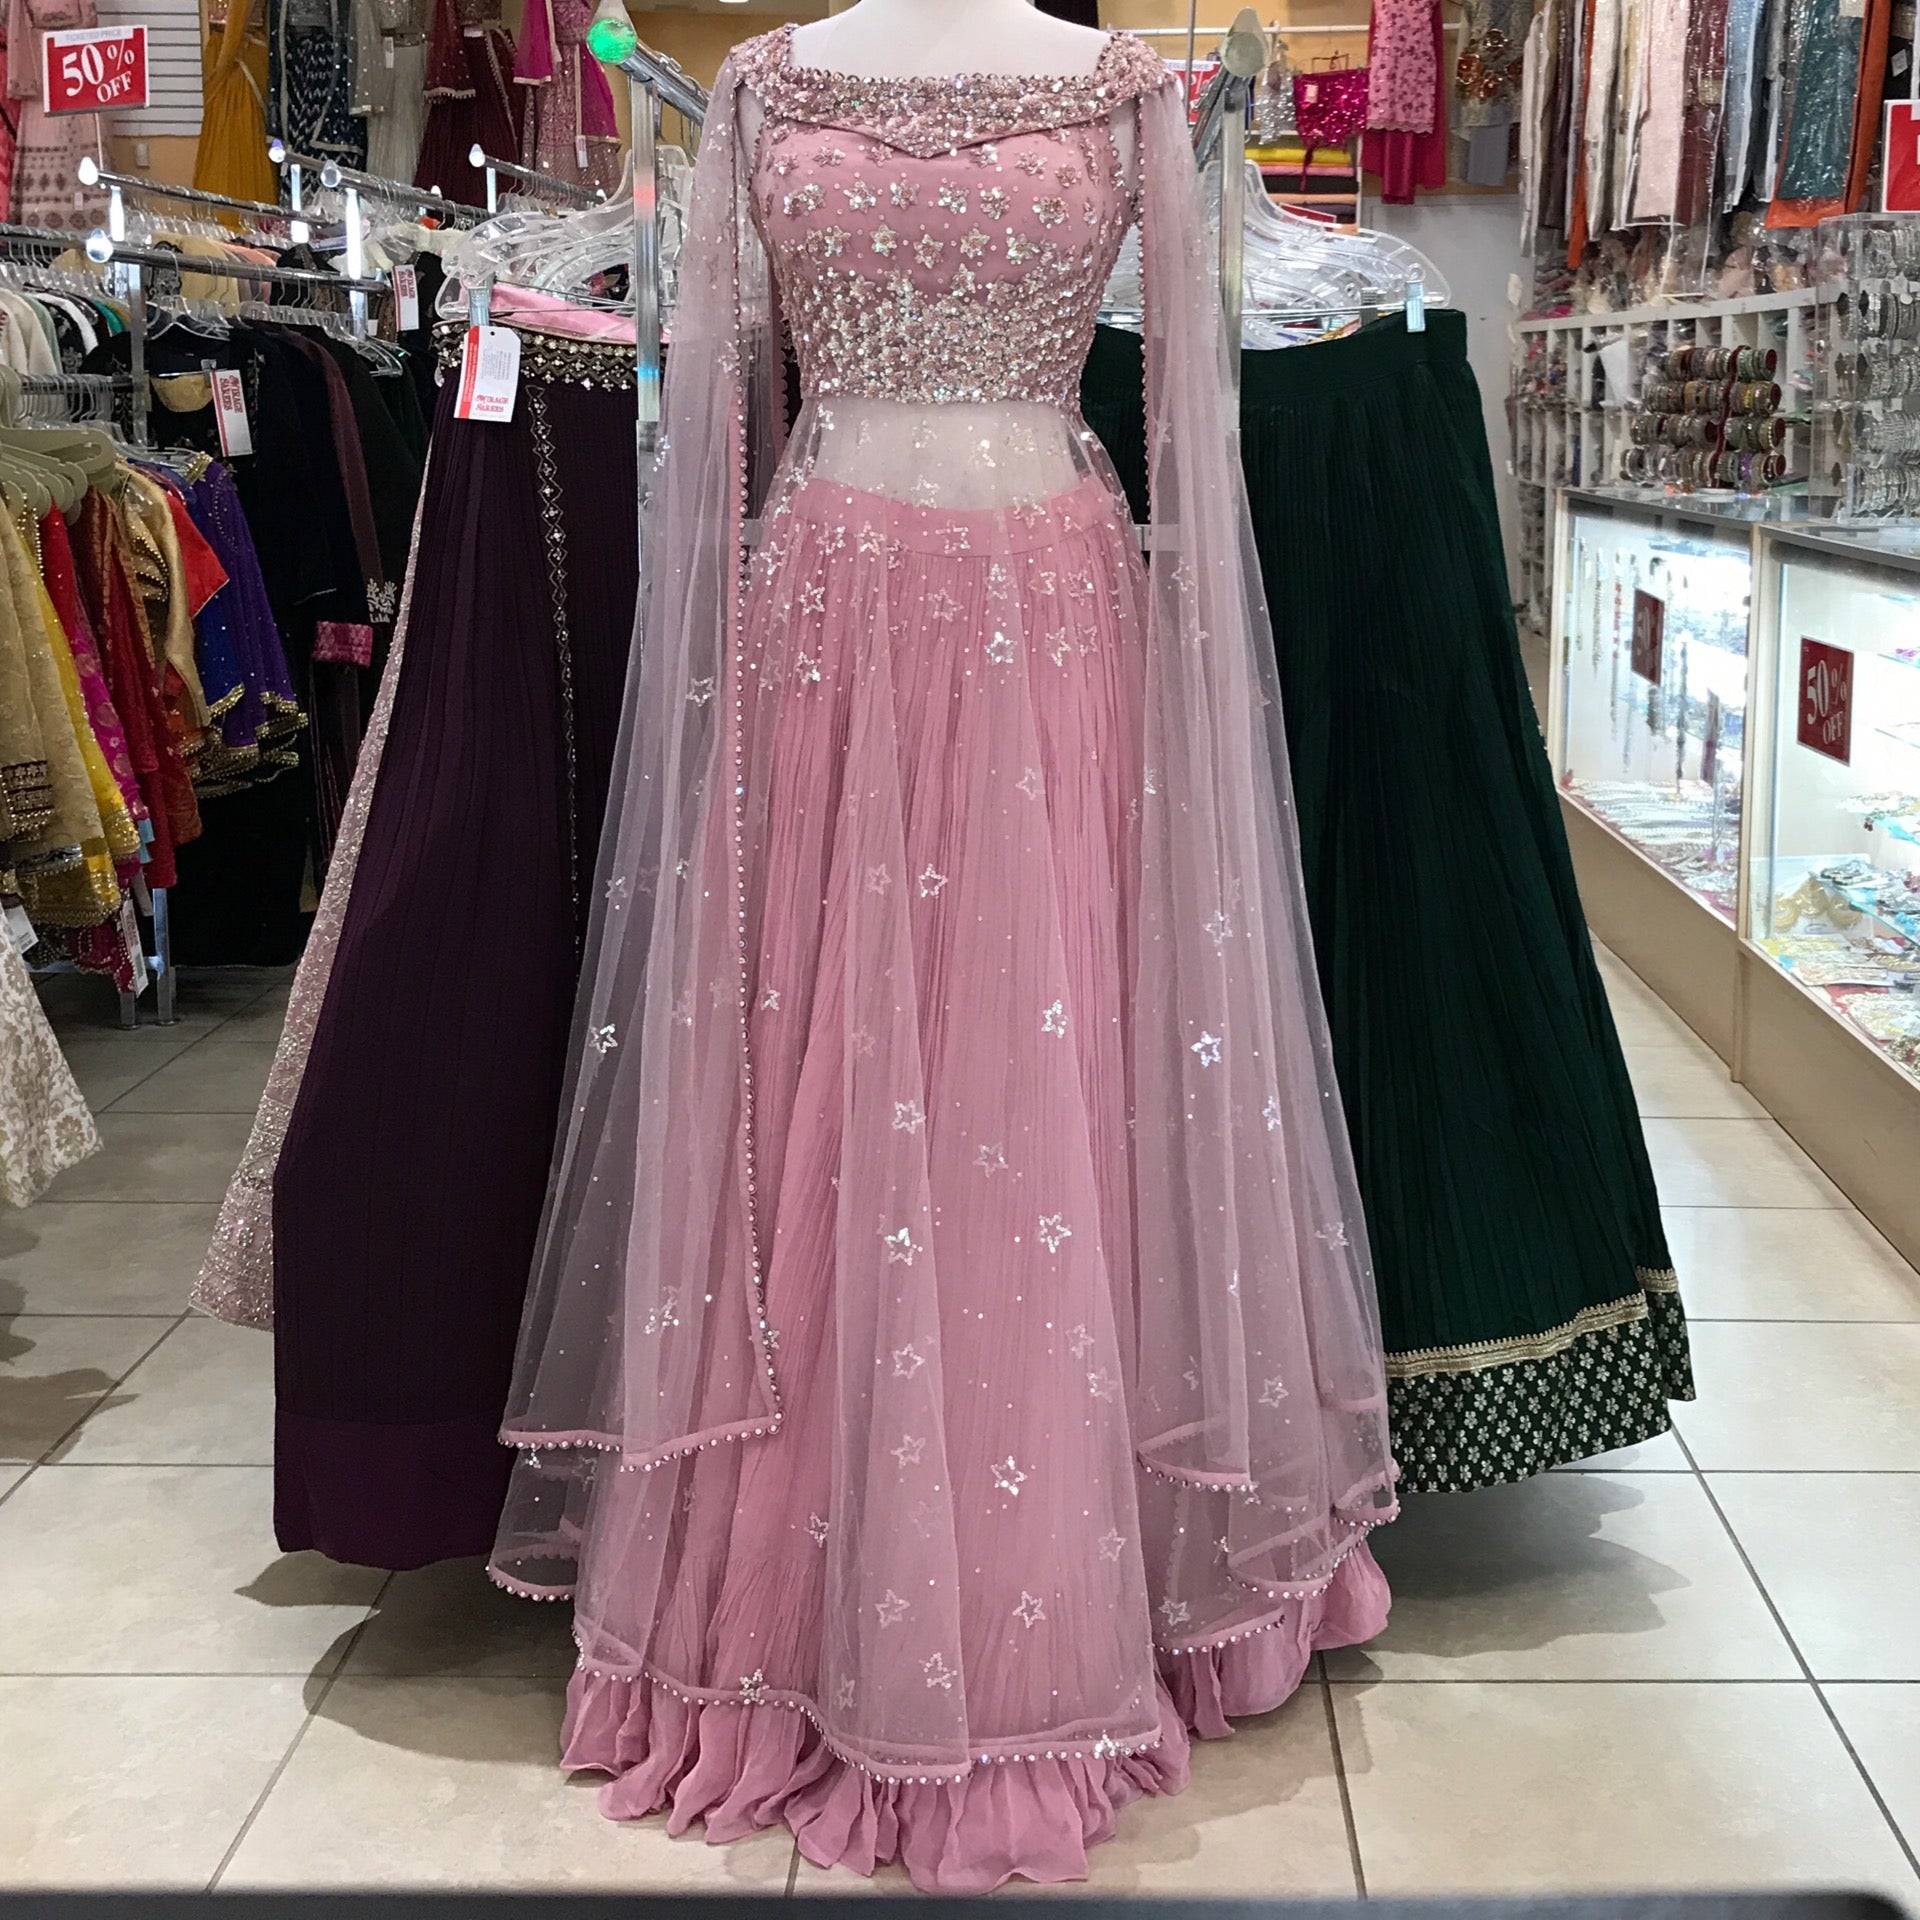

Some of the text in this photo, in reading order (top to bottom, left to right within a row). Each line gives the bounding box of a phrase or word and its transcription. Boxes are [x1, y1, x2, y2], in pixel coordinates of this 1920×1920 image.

[62, 40, 135, 97] 50%
[96, 70, 132, 103] OFF
[1823, 710, 1844, 745] OFF
